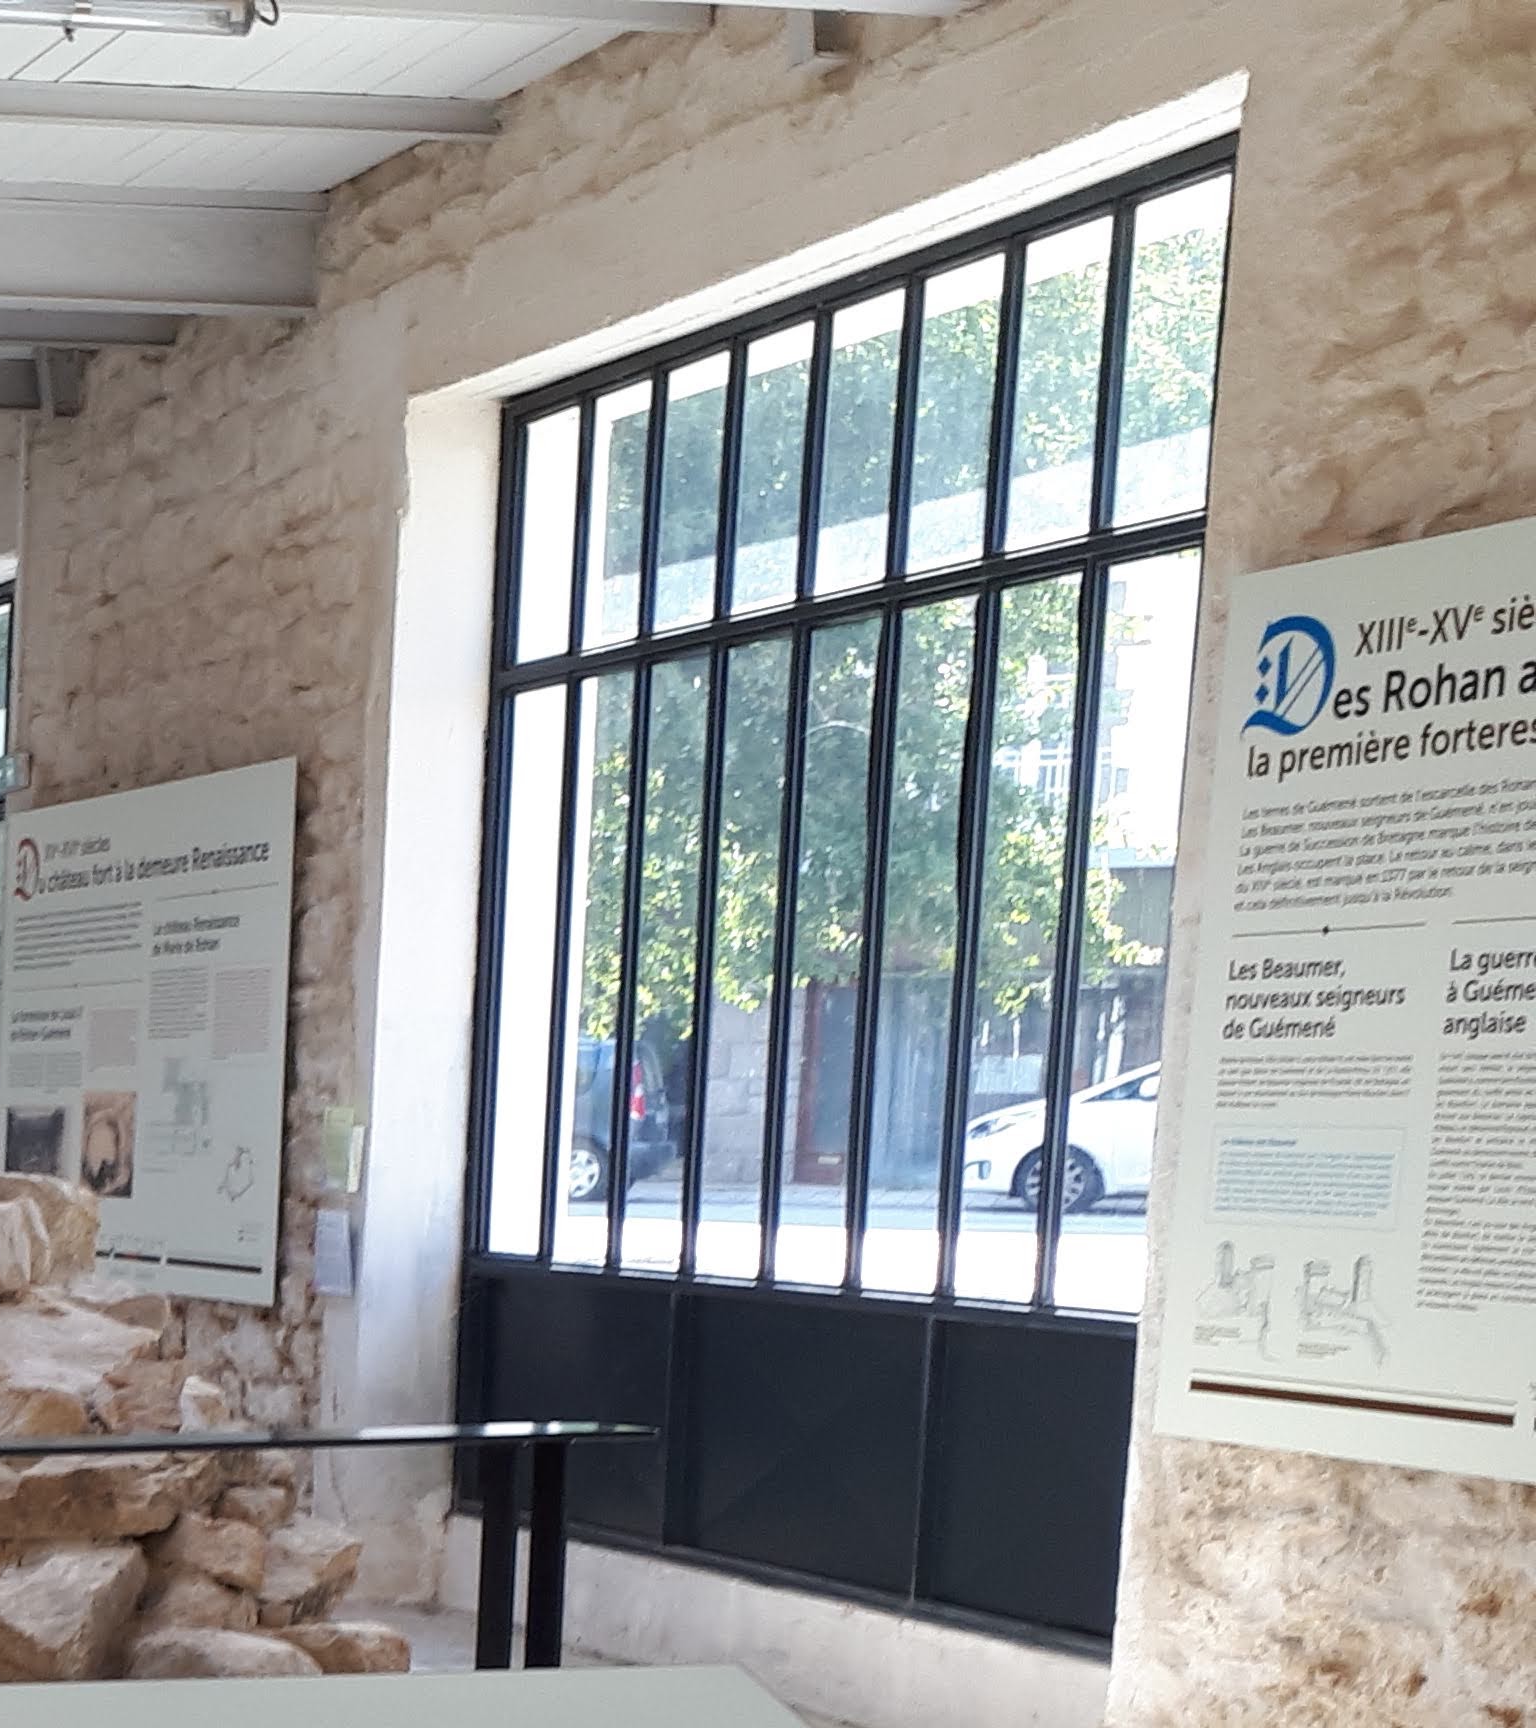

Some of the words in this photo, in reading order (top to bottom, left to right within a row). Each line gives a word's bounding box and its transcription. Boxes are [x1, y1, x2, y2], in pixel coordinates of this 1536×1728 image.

[1383, 662, 1505, 713] Rohan
[1246, 744, 1270, 780] la
[1278, 729, 1409, 783] première
[1227, 958, 1257, 981] Les
[1261, 957, 1346, 981] Beaumer,
[1450, 948, 1472, 972] La
[1224, 988, 1313, 1010] nouveaux
[1315, 984, 1408, 1012] seigneurs
[1222, 1020, 1244, 1040] de
[1249, 1015, 1337, 1040] Guémené
[1443, 1010, 1527, 1041] anglaise
